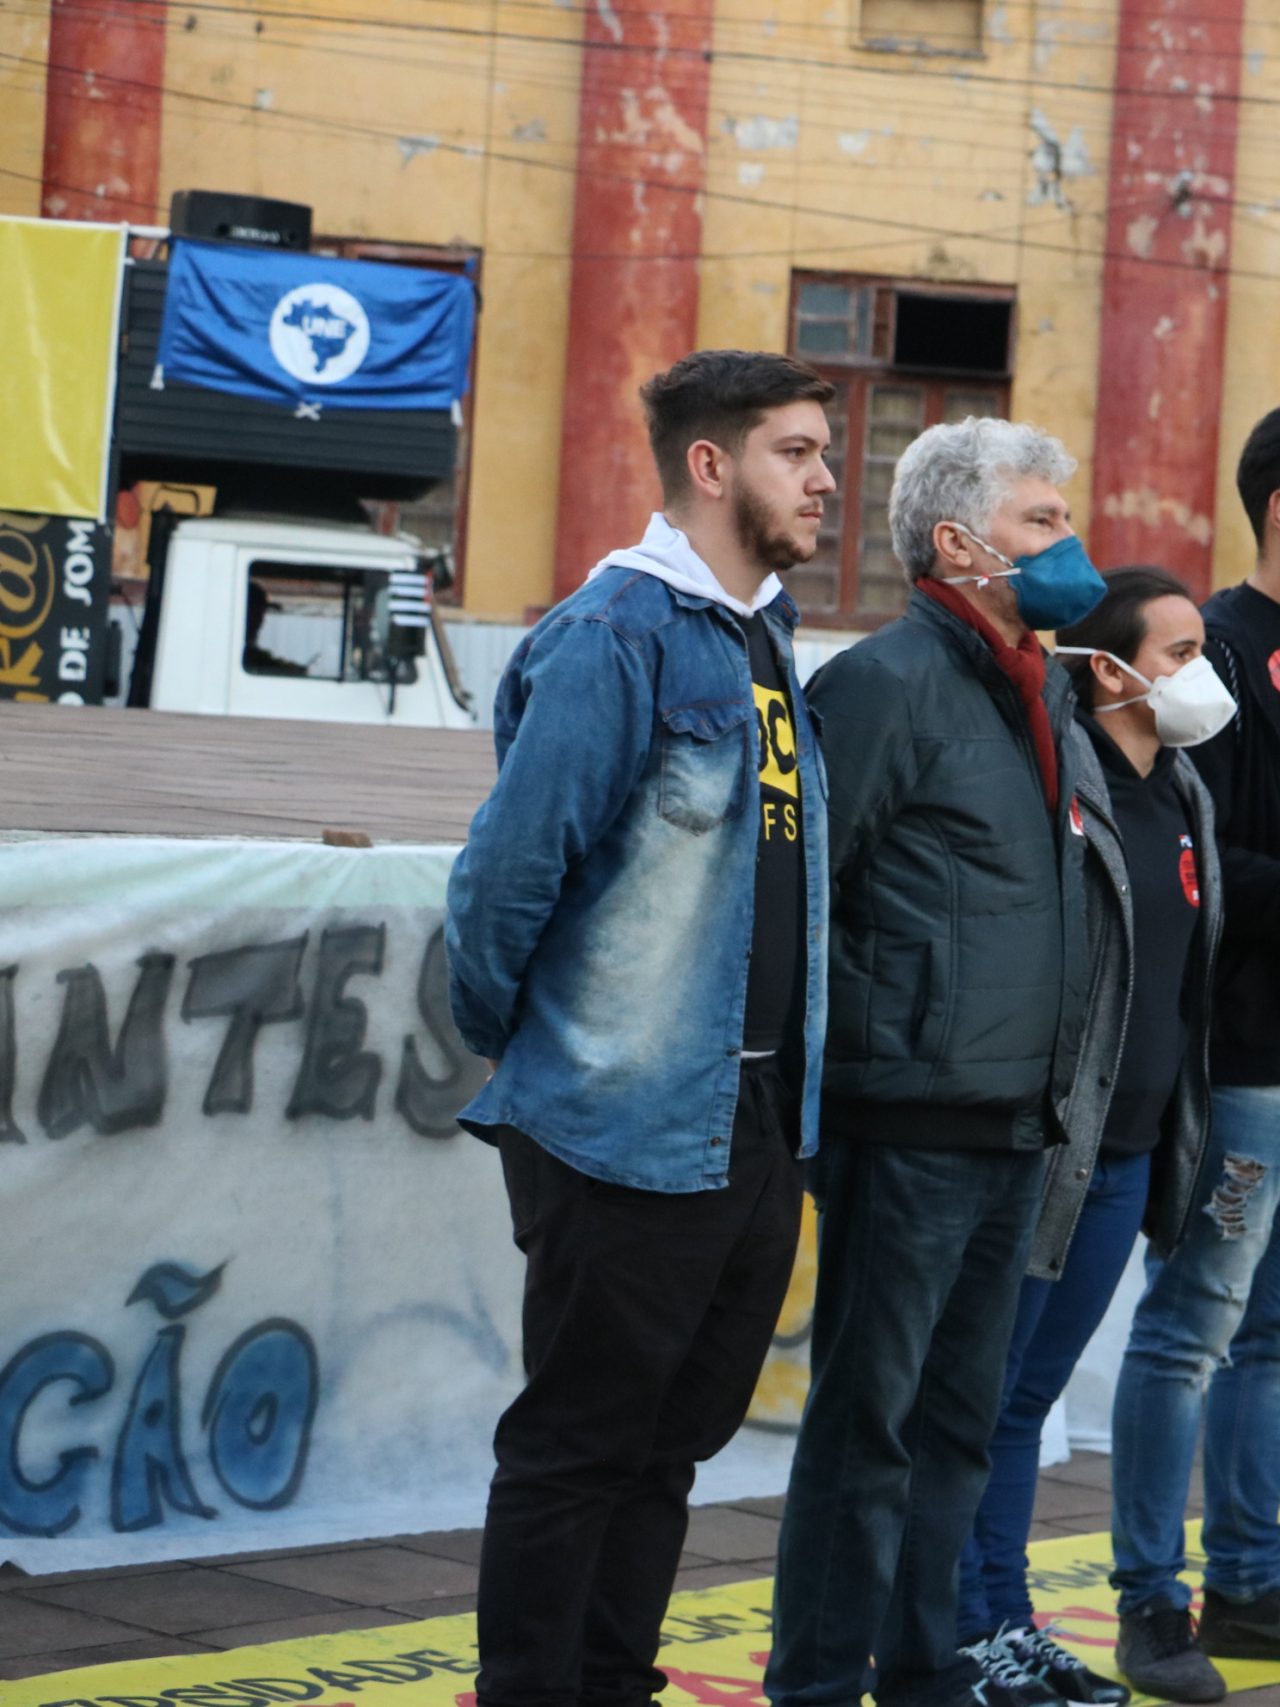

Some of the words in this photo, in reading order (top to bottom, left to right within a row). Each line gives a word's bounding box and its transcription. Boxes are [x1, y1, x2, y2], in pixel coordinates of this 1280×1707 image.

[302, 315, 346, 338] UNE
[63, 520, 95, 607] SOM
[58, 626, 90, 683] DE
